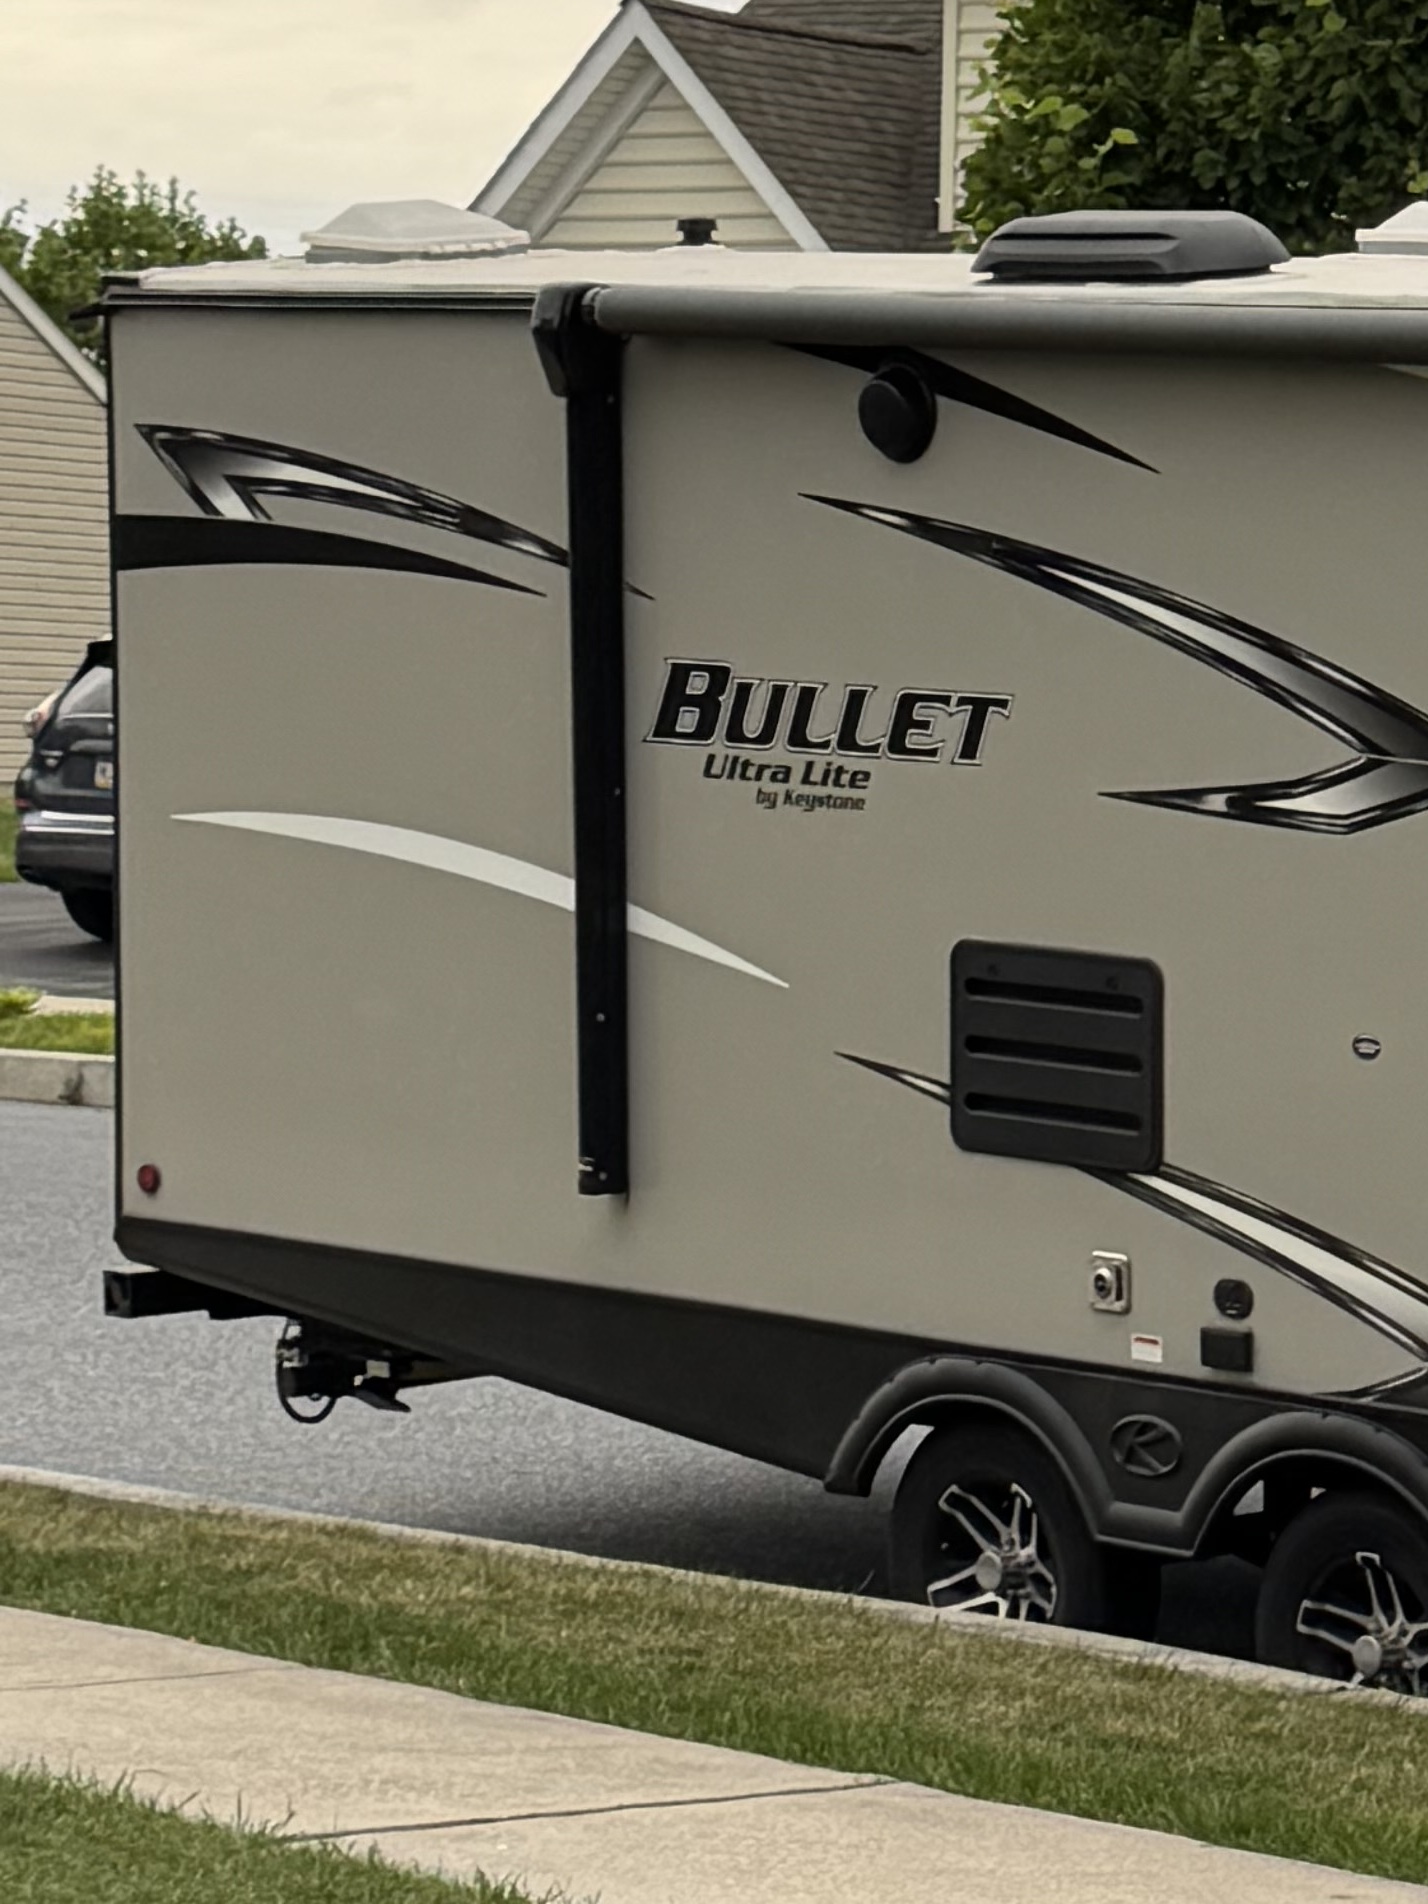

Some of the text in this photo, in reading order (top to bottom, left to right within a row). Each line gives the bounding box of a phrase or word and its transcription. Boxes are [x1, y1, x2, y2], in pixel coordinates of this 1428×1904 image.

[642, 656, 1015, 767] BULLET
[703, 752, 872, 790] Ultra Lite
[756, 787, 867, 813] by Keystone
